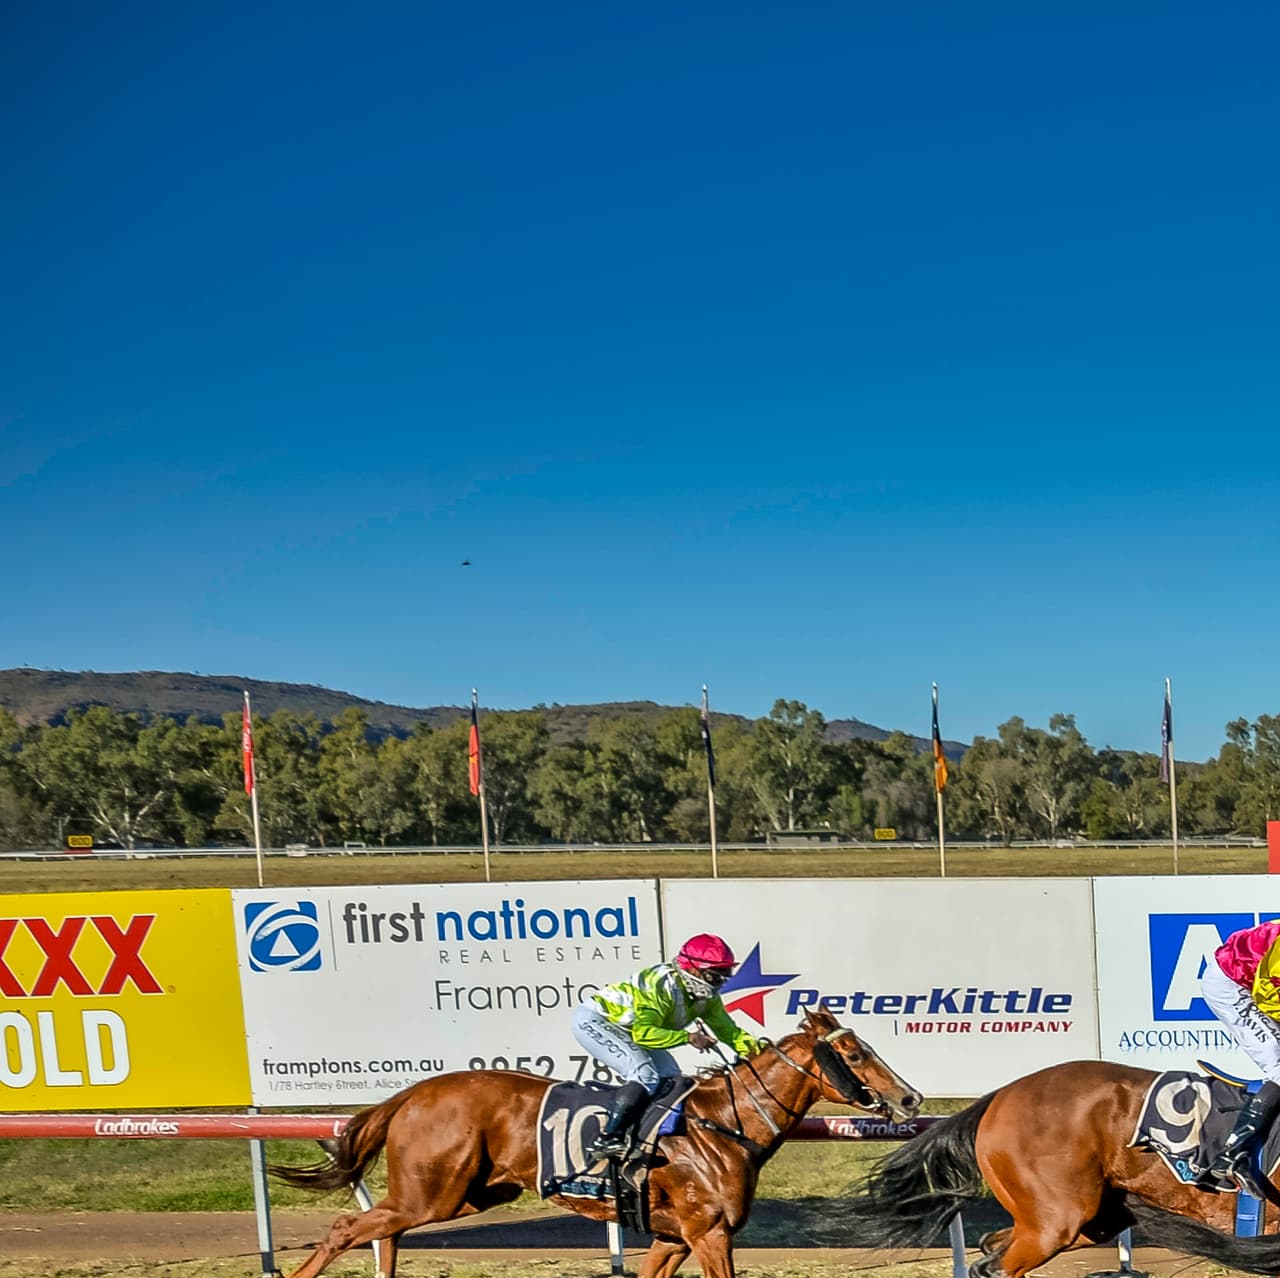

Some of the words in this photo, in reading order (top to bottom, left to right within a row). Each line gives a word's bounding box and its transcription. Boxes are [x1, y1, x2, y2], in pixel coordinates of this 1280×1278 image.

[343, 902, 425, 943] first
[436, 897, 639, 941] national
[440, 948, 512, 964] REAL
[537, 946, 640, 962] ESTATE
[434, 977, 608, 1016] Frampto
[785, 988, 1073, 1015] PeterKittle
[905, 1022, 972, 1034] MOTOR
[980, 1021, 1073, 1033] COMPANY
[262, 1057, 444, 1078] framptons.com.au
[375, 1078, 401, 1089] Alice
[1155, 1077, 1212, 1154] 9
[94, 1118, 180, 1136] Ladbrokes
